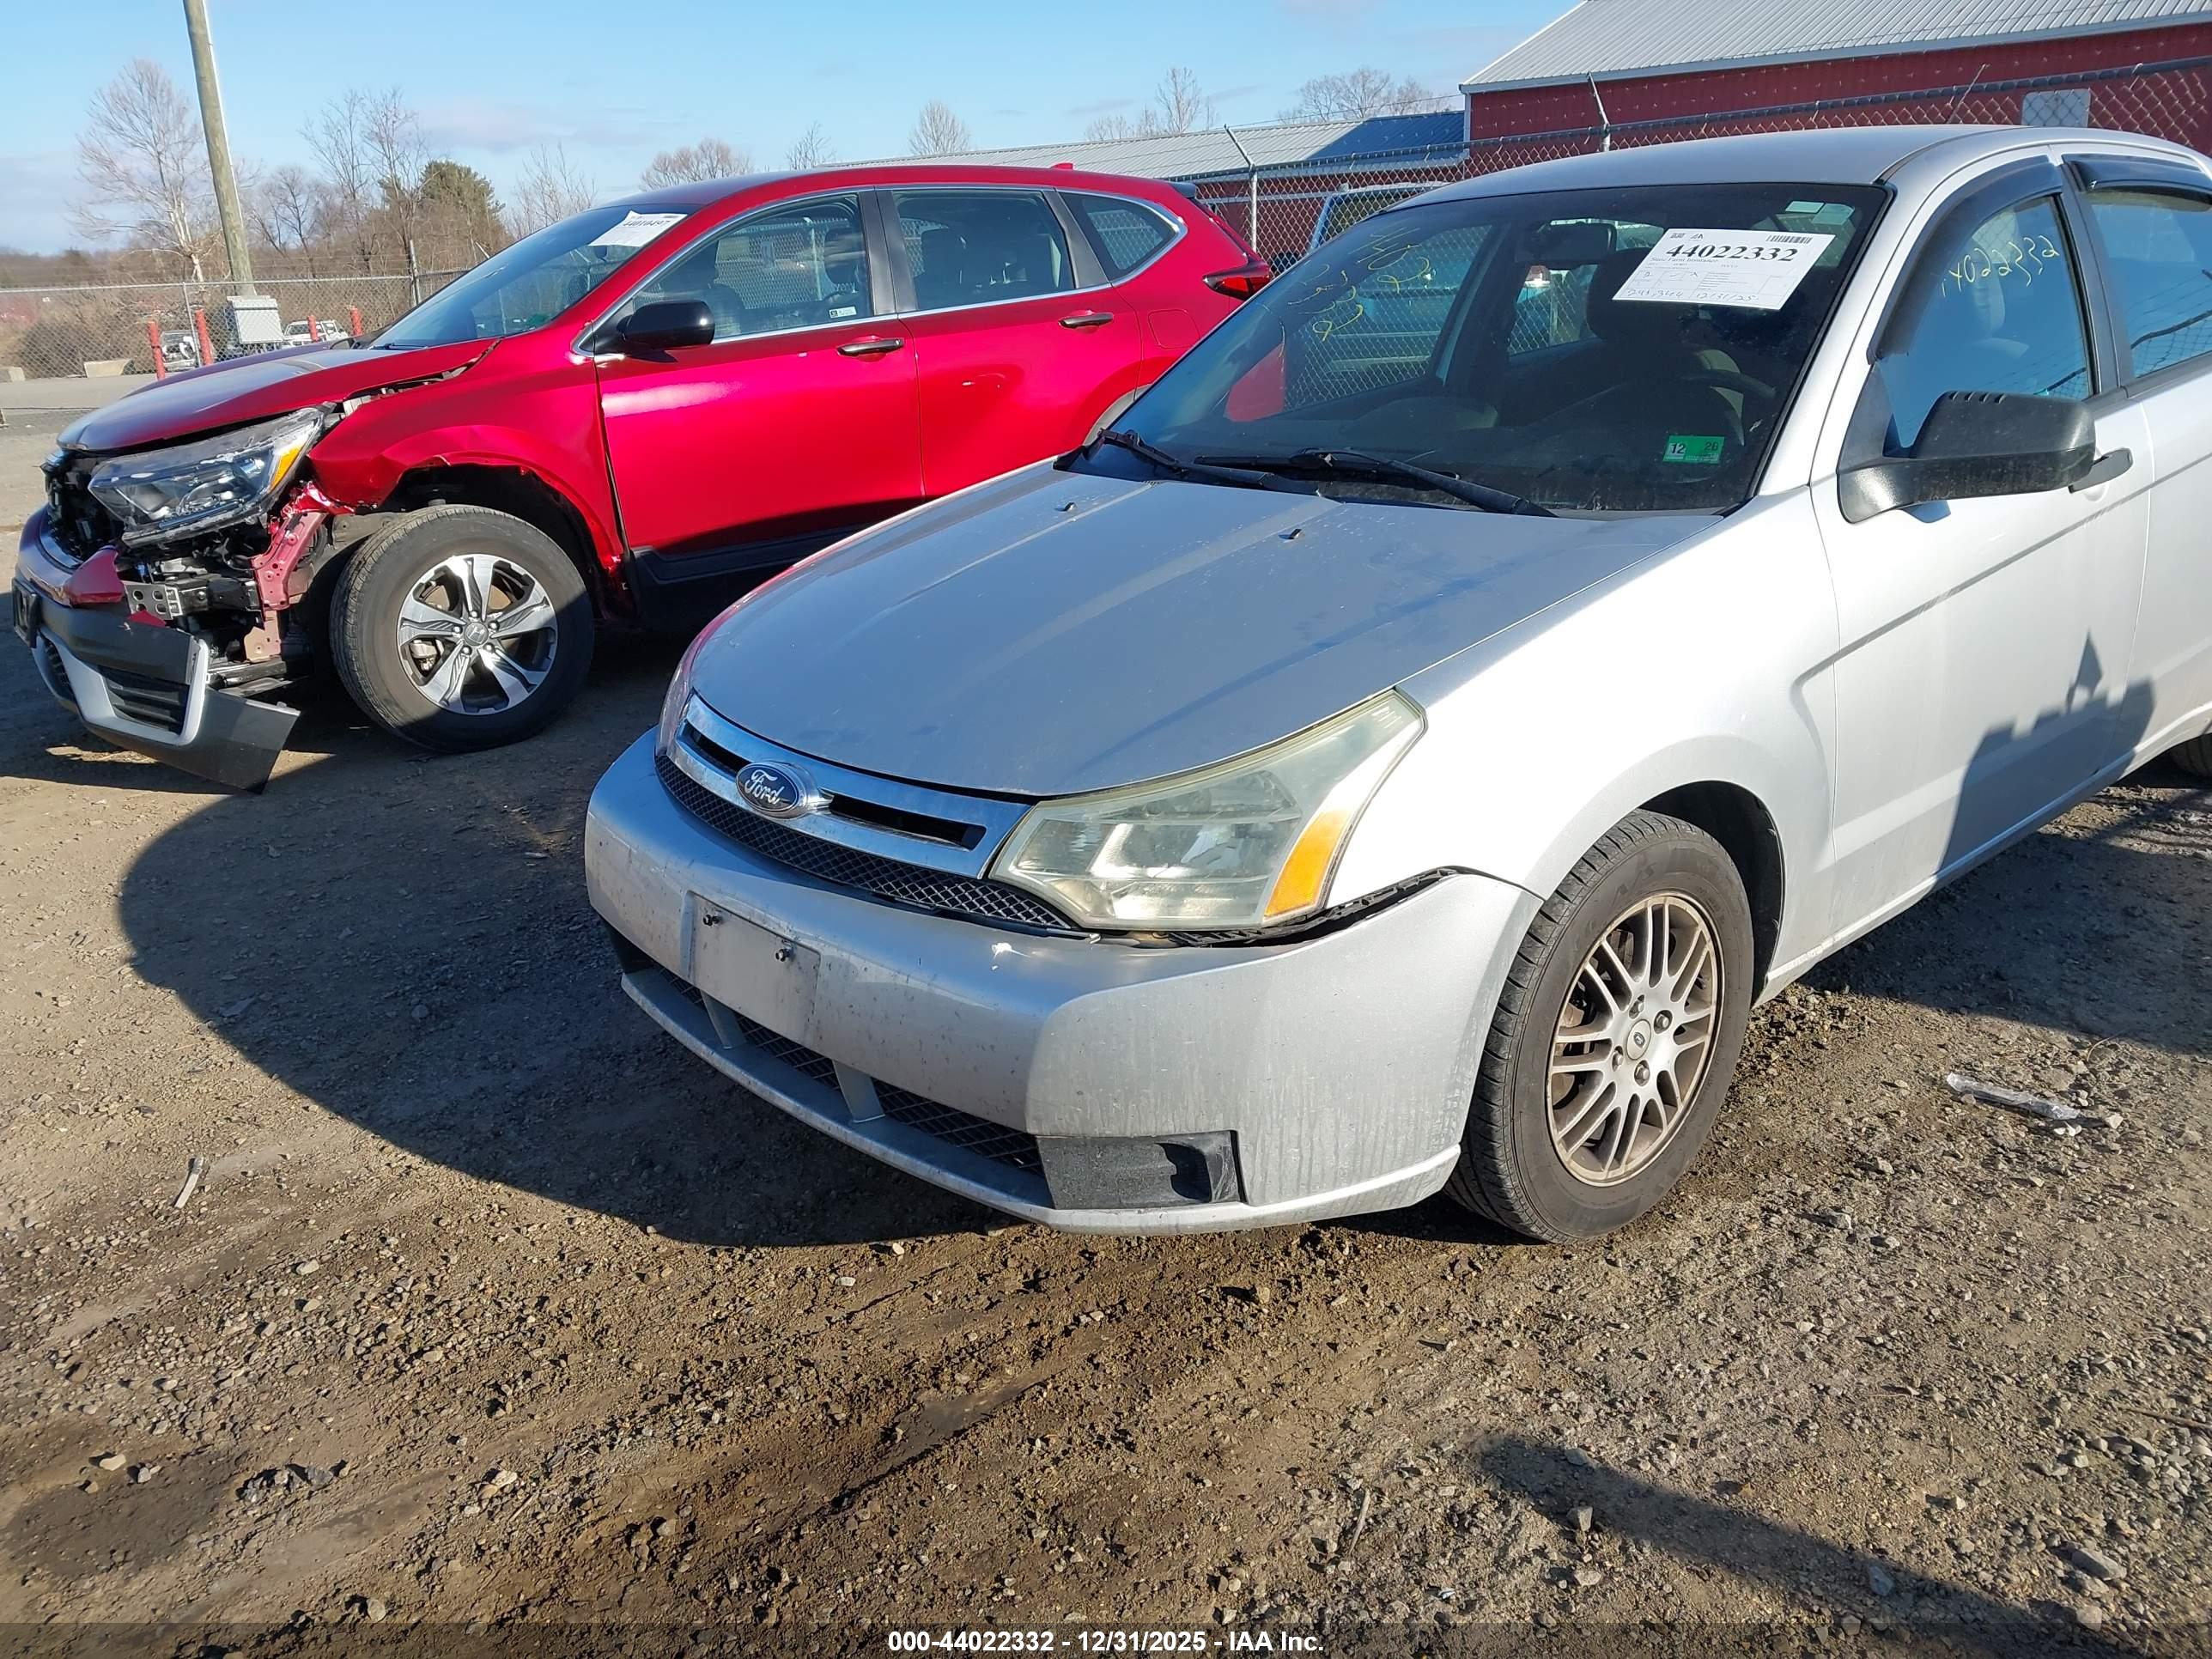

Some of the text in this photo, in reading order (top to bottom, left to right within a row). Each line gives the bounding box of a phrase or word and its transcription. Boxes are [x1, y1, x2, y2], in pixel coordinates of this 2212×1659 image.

[1666, 244, 1798, 262] 44022332
[1671, 442, 1686, 454] 12
[744, 769, 785, 805] Ford
